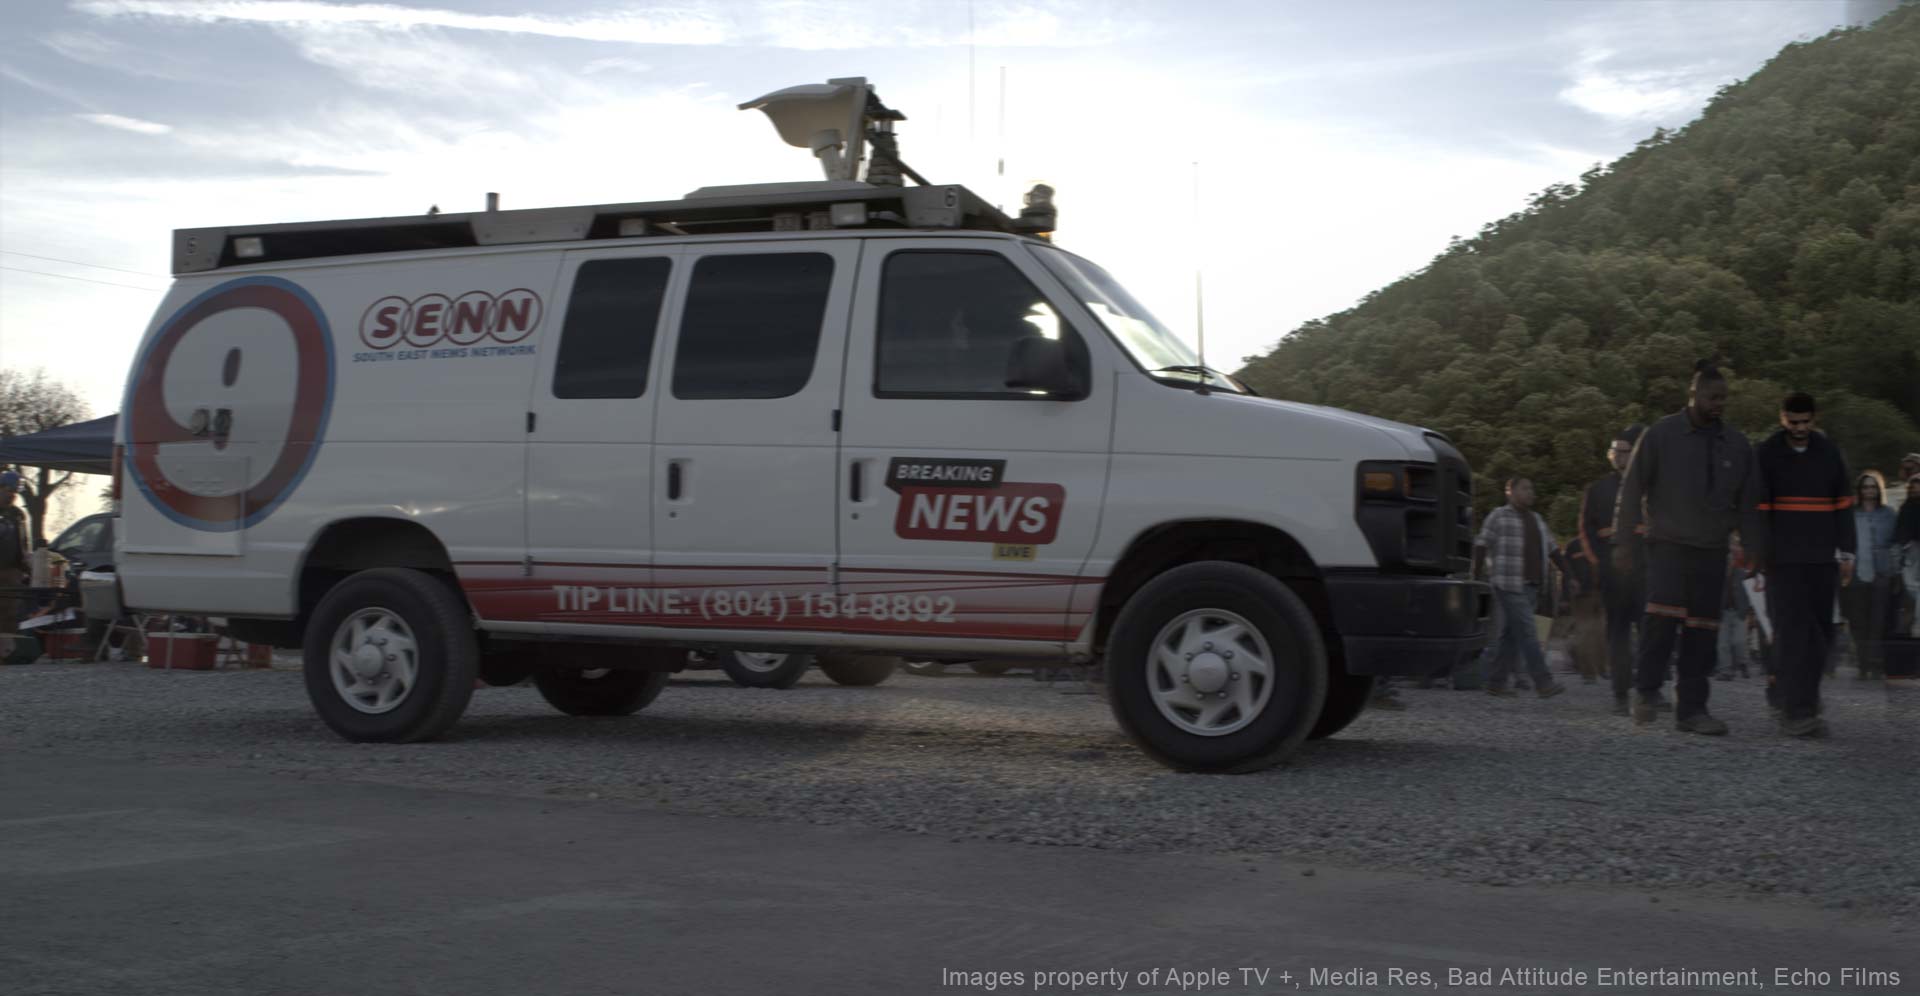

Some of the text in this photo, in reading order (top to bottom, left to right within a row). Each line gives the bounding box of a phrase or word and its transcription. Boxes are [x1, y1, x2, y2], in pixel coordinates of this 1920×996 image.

[370, 298, 533, 340] SENN
[353, 345, 537, 362] SOUTH EAST NEWS NETWORK
[897, 464, 993, 481] BREAKING
[908, 493, 1050, 534] NEWS
[999, 546, 1031, 558] LIVE
[554, 585, 956, 623] TIP LINE: (804) 154-8892
